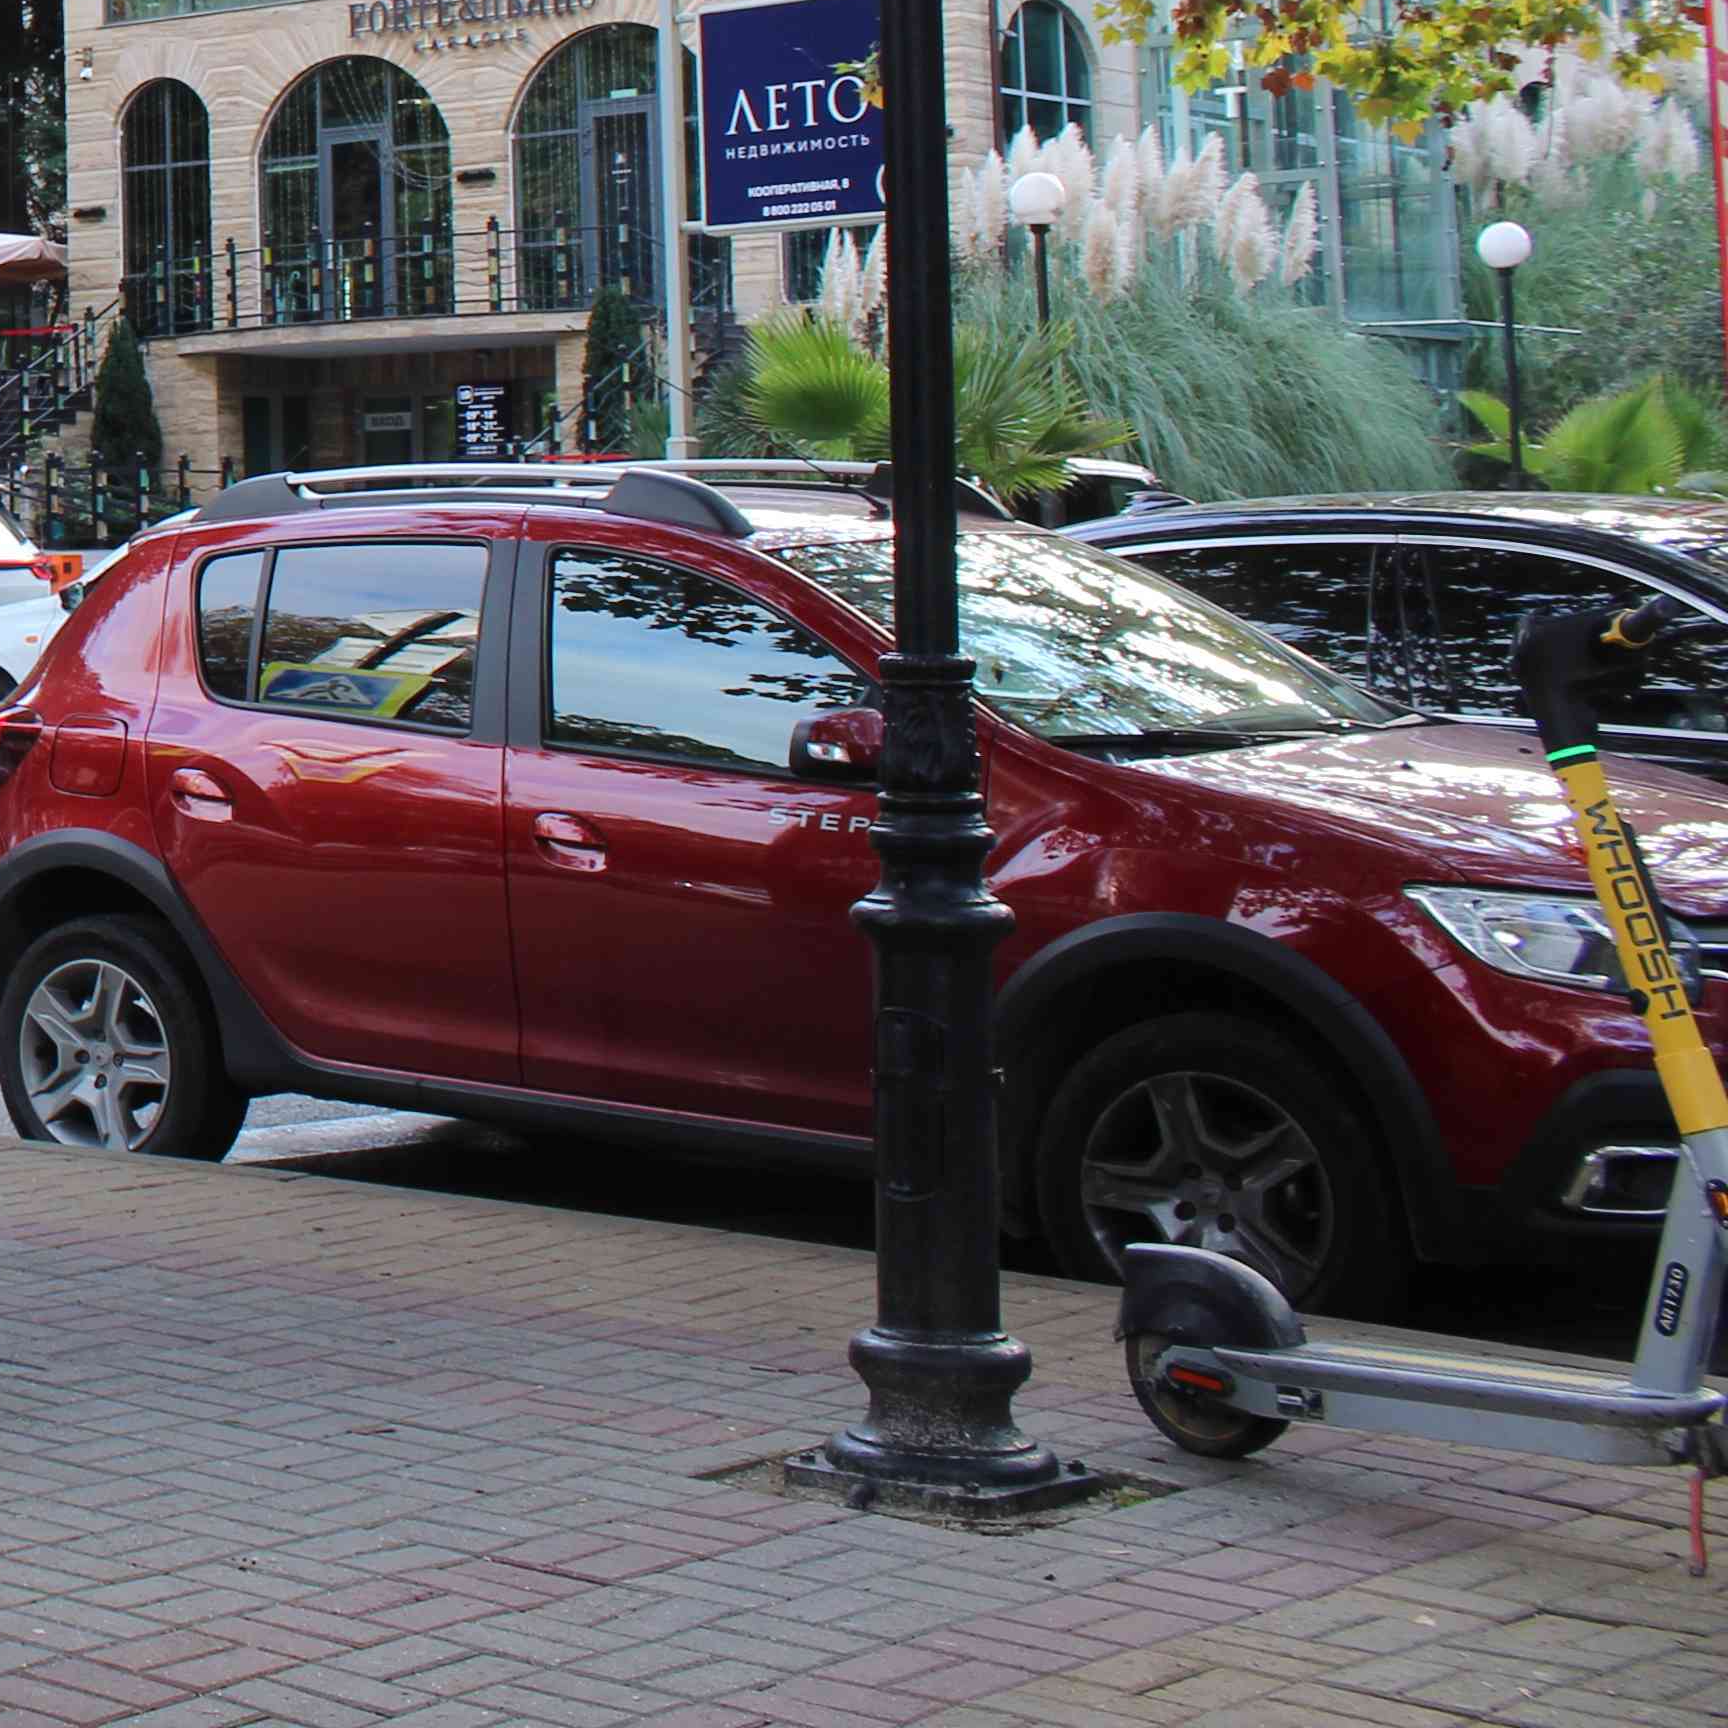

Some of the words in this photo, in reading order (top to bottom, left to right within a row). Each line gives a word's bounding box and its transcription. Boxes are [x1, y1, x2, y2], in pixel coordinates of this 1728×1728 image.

[725, 134, 871, 160] НЕДВИЖИМОСТЬ
[768, 807, 871, 833] STEP
[1585, 798, 1689, 1020] WHOOSH
